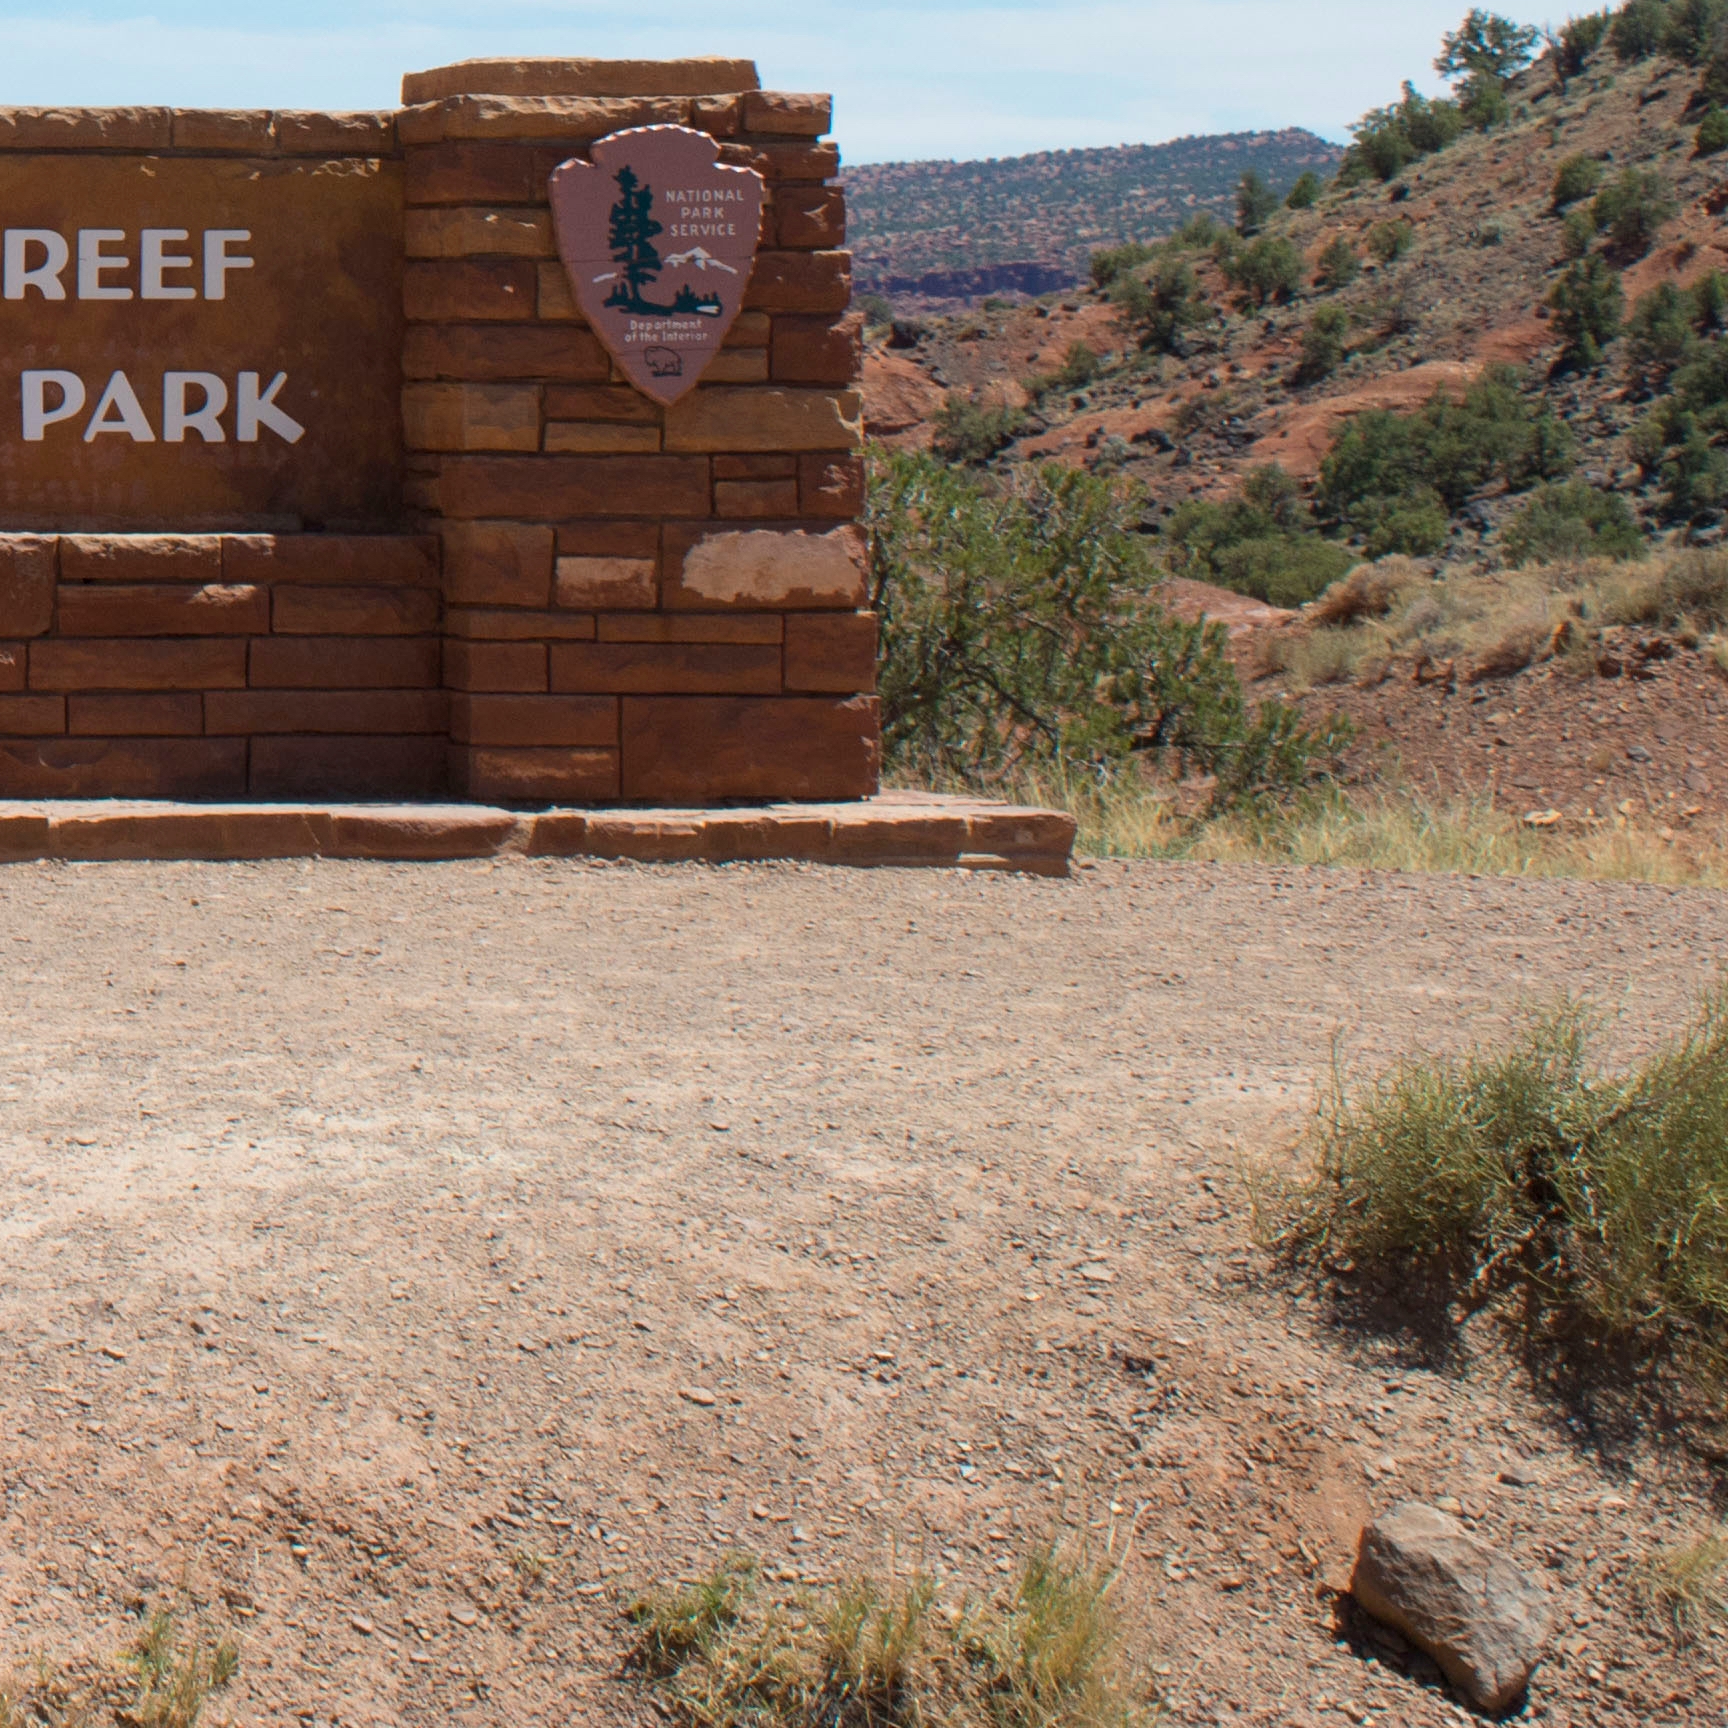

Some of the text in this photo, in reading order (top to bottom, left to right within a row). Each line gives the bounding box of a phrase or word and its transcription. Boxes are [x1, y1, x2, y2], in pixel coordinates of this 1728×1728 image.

[665, 189, 744, 203] NATIONAL
[680, 206, 725, 219] PARK
[670, 223, 737, 237] SERVICE
[3, 228, 255, 301] REEF
[629, 319, 702, 331] Department
[624, 331, 708, 343] of the Interior
[20, 368, 306, 445] PARK
